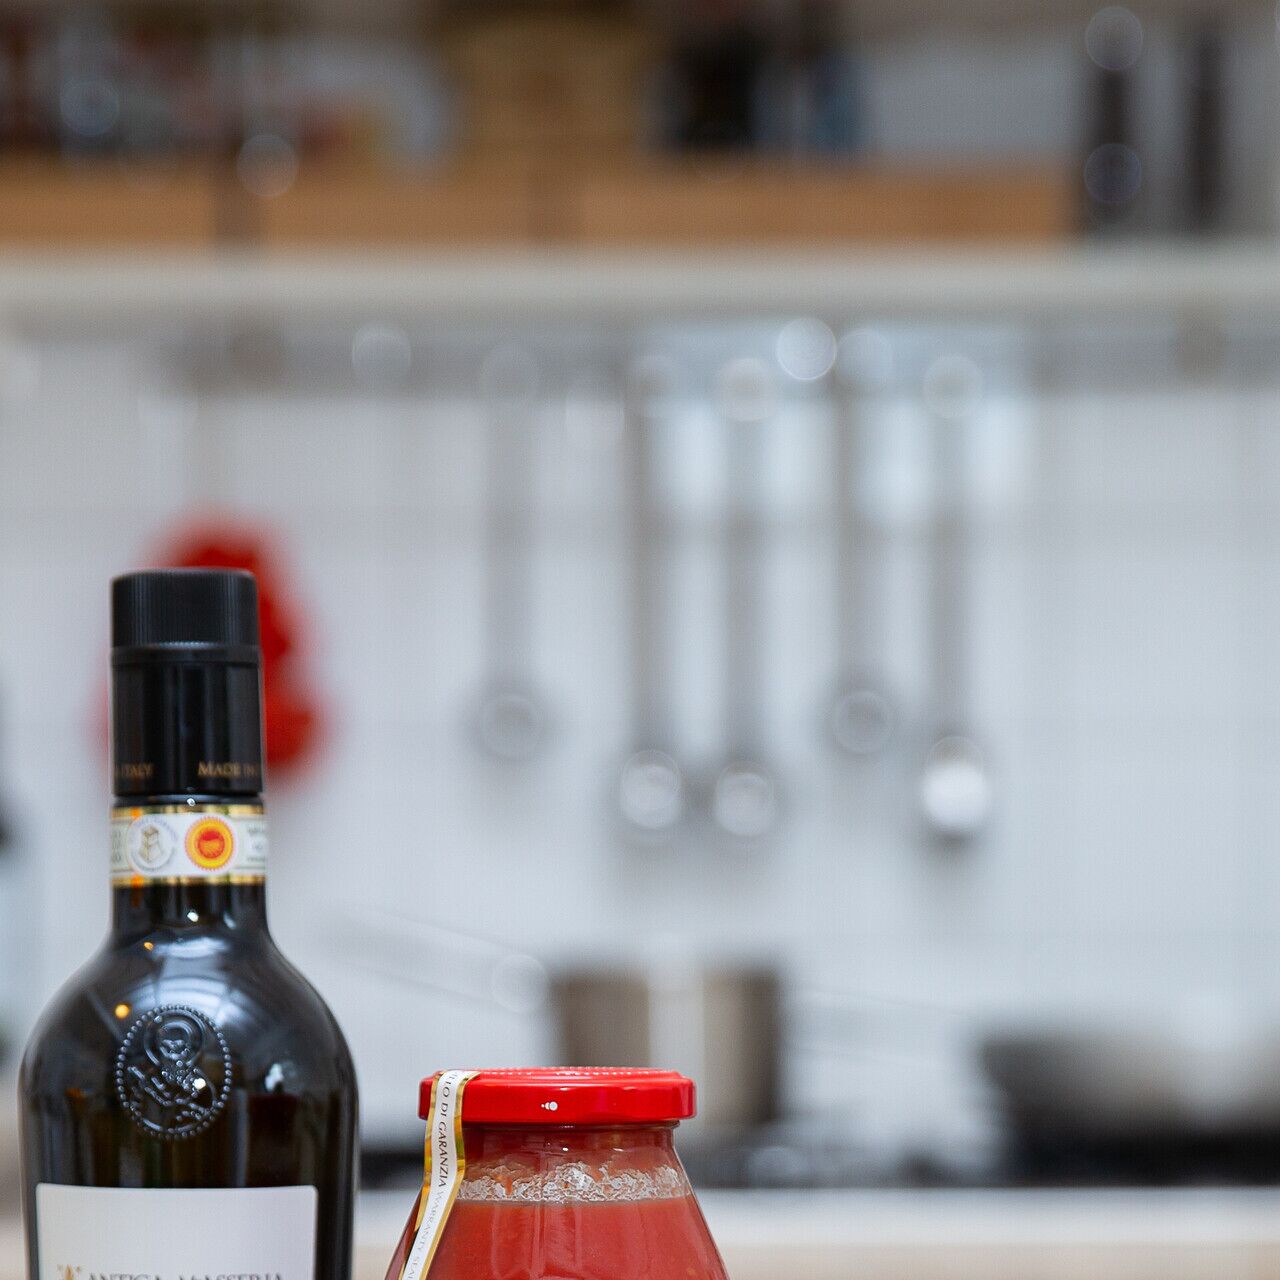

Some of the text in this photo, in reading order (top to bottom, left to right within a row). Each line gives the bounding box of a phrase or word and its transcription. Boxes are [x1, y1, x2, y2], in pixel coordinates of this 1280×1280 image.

[197, 761, 241, 776] MADE
[440, 1102, 449, 1117] DI
[438, 1121, 449, 1187] GARANZIA
